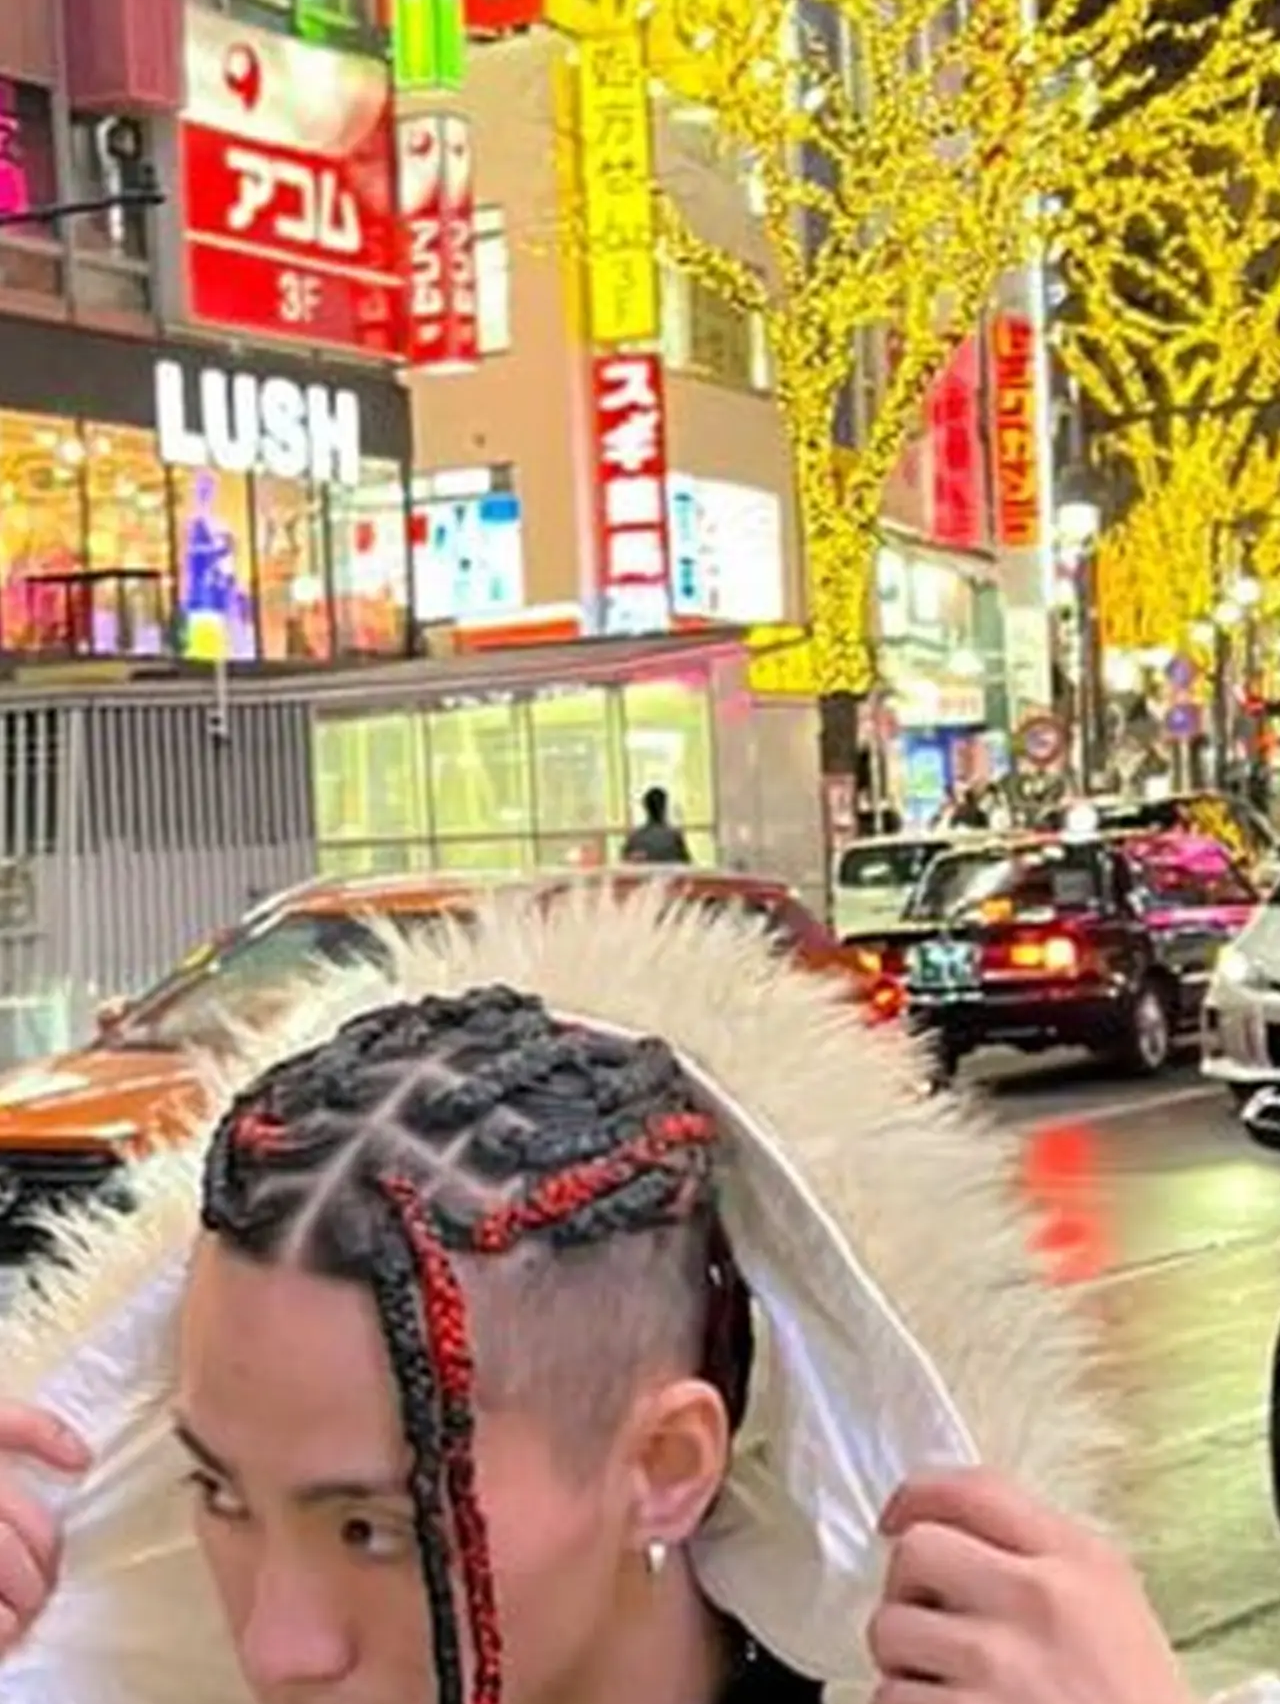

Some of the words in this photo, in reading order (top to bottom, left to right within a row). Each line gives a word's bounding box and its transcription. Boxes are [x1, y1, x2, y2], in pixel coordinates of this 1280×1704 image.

[226, 150, 360, 252] アコム
[279, 271, 324, 324] 3F
[156, 361, 360, 484] LUSH
